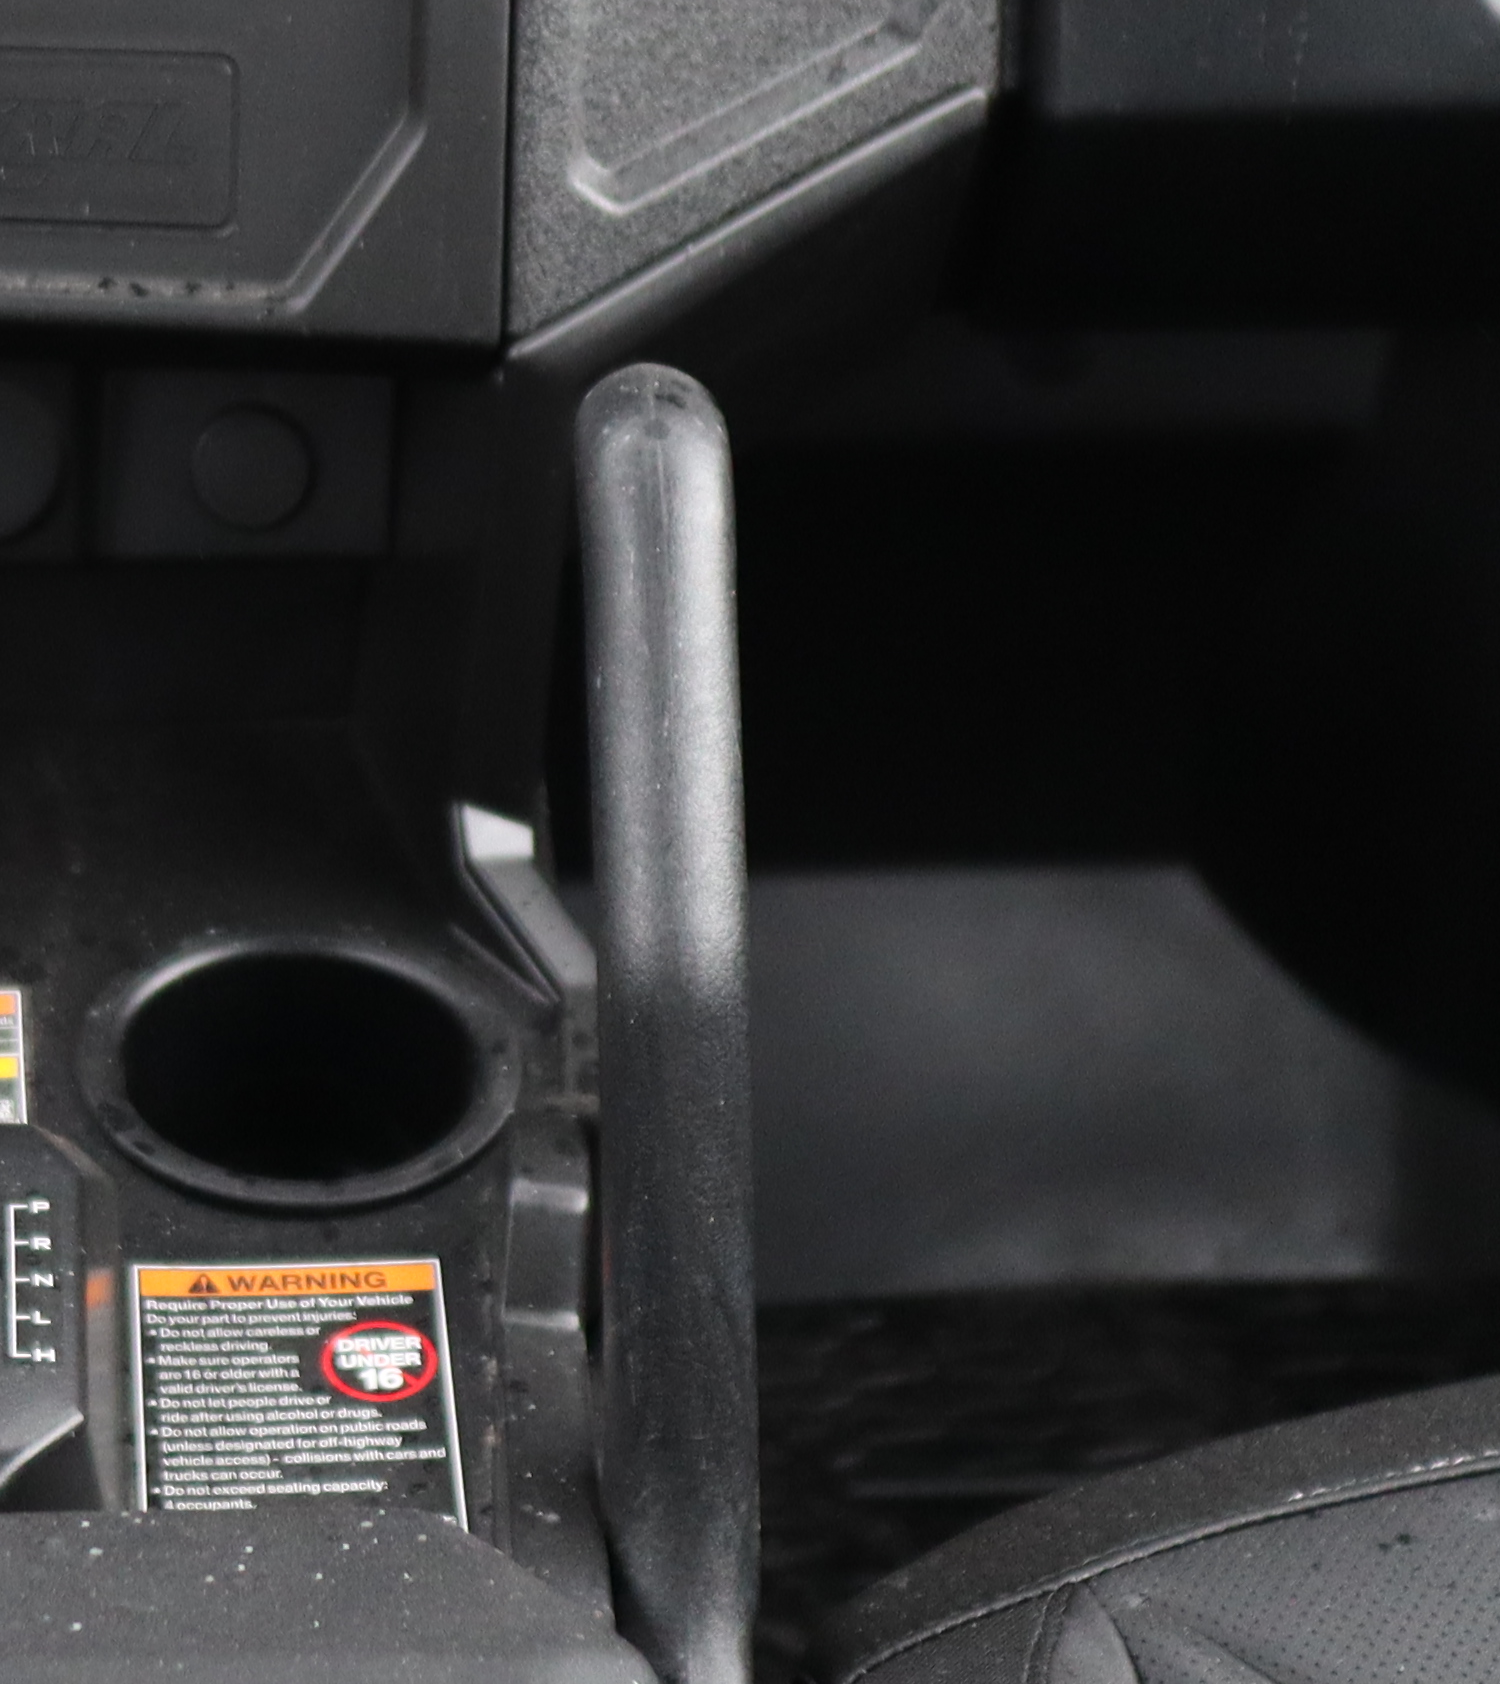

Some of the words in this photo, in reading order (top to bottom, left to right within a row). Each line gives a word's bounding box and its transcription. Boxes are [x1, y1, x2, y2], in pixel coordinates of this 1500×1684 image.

[31, 1201, 50, 1214] P
[32, 1237, 51, 1250] R
[34, 1273, 54, 1287] N
[227, 1272, 387, 1292] WARNING
[145, 1299, 208, 1312] Require
[209, 1299, 263, 1312] Proper
[265, 1298, 297, 1309] Use
[300, 1297, 315, 1308] of
[318, 1297, 354, 1308] Your
[356, 1295, 414, 1306] Vehicle
[33, 1310, 51, 1324] L
[146, 1314, 166, 1324] Do
[168, 1315, 200, 1326] your
[201, 1314, 230, 1326] part
[231, 1314, 246, 1324] to
[247, 1312, 302, 1324] prevent
[160, 1328, 180, 1337] Do
[181, 1328, 204, 1337] not
[205, 1327, 244, 1337] allow
[245, 1326, 304, 1337] careless
[305, 1326, 321, 1336] or
[160, 1342, 219, 1352] reckless
[336, 1335, 422, 1352] DRIVER
[33, 1348, 56, 1362] H
[159, 1356, 197, 1366] Make
[198, 1356, 230, 1366] sure
[231, 1354, 299, 1367] operators
[339, 1352, 422, 1369] UNDER
[159, 1371, 182, 1380] are
[184, 1369, 201, 1380] 16
[203, 1371, 218, 1380] or
[220, 1368, 257, 1379] older
[257, 1368, 288, 1378] with
[290, 1369, 300, 1378] a
[358, 1367, 405, 1390] 16
[160, 1383, 194, 1394] valid
[161, 1398, 180, 1408] Do
[182, 1398, 207, 1408] not
[208, 1397, 227, 1408] let
[228, 1396, 277, 1409] people
[279, 1395, 315, 1406] drive
[316, 1396, 332, 1405] or
[161, 1412, 188, 1423] ride
[190, 1411, 223, 1423] after
[225, 1412, 265, 1424] using
[265, 1409, 318, 1421] alcohol
[320, 1410, 335, 1420] or
[161, 1426, 182, 1437] Do
[183, 1426, 208, 1437] not
[209, 1425, 248, 1436] allow
[248, 1423, 317, 1437] operation
[319, 1424, 338, 1433] on
[340, 1421, 384, 1434] public
[385, 1419, 428, 1431] roads
[162, 1441, 213, 1454] (unless
[215, 1438, 295, 1453] designated
[296, 1437, 317, 1448] for
[319, 1436, 402, 1449] off-highway
[162, 1455, 214, 1467] vehicle
[214, 1453, 270, 1466] access)
[284, 1452, 352, 1464] collisions
[353, 1449, 384, 1462] with
[386, 1450, 418, 1460] cars
[418, 1447, 447, 1460] and
[162, 1470, 209, 1481] trucks
[209, 1471, 238, 1480] can
[164, 1485, 185, 1496] Do
[186, 1485, 211, 1496] not
[212, 1484, 266, 1495] exceed
[267, 1482, 321, 1495] seating
